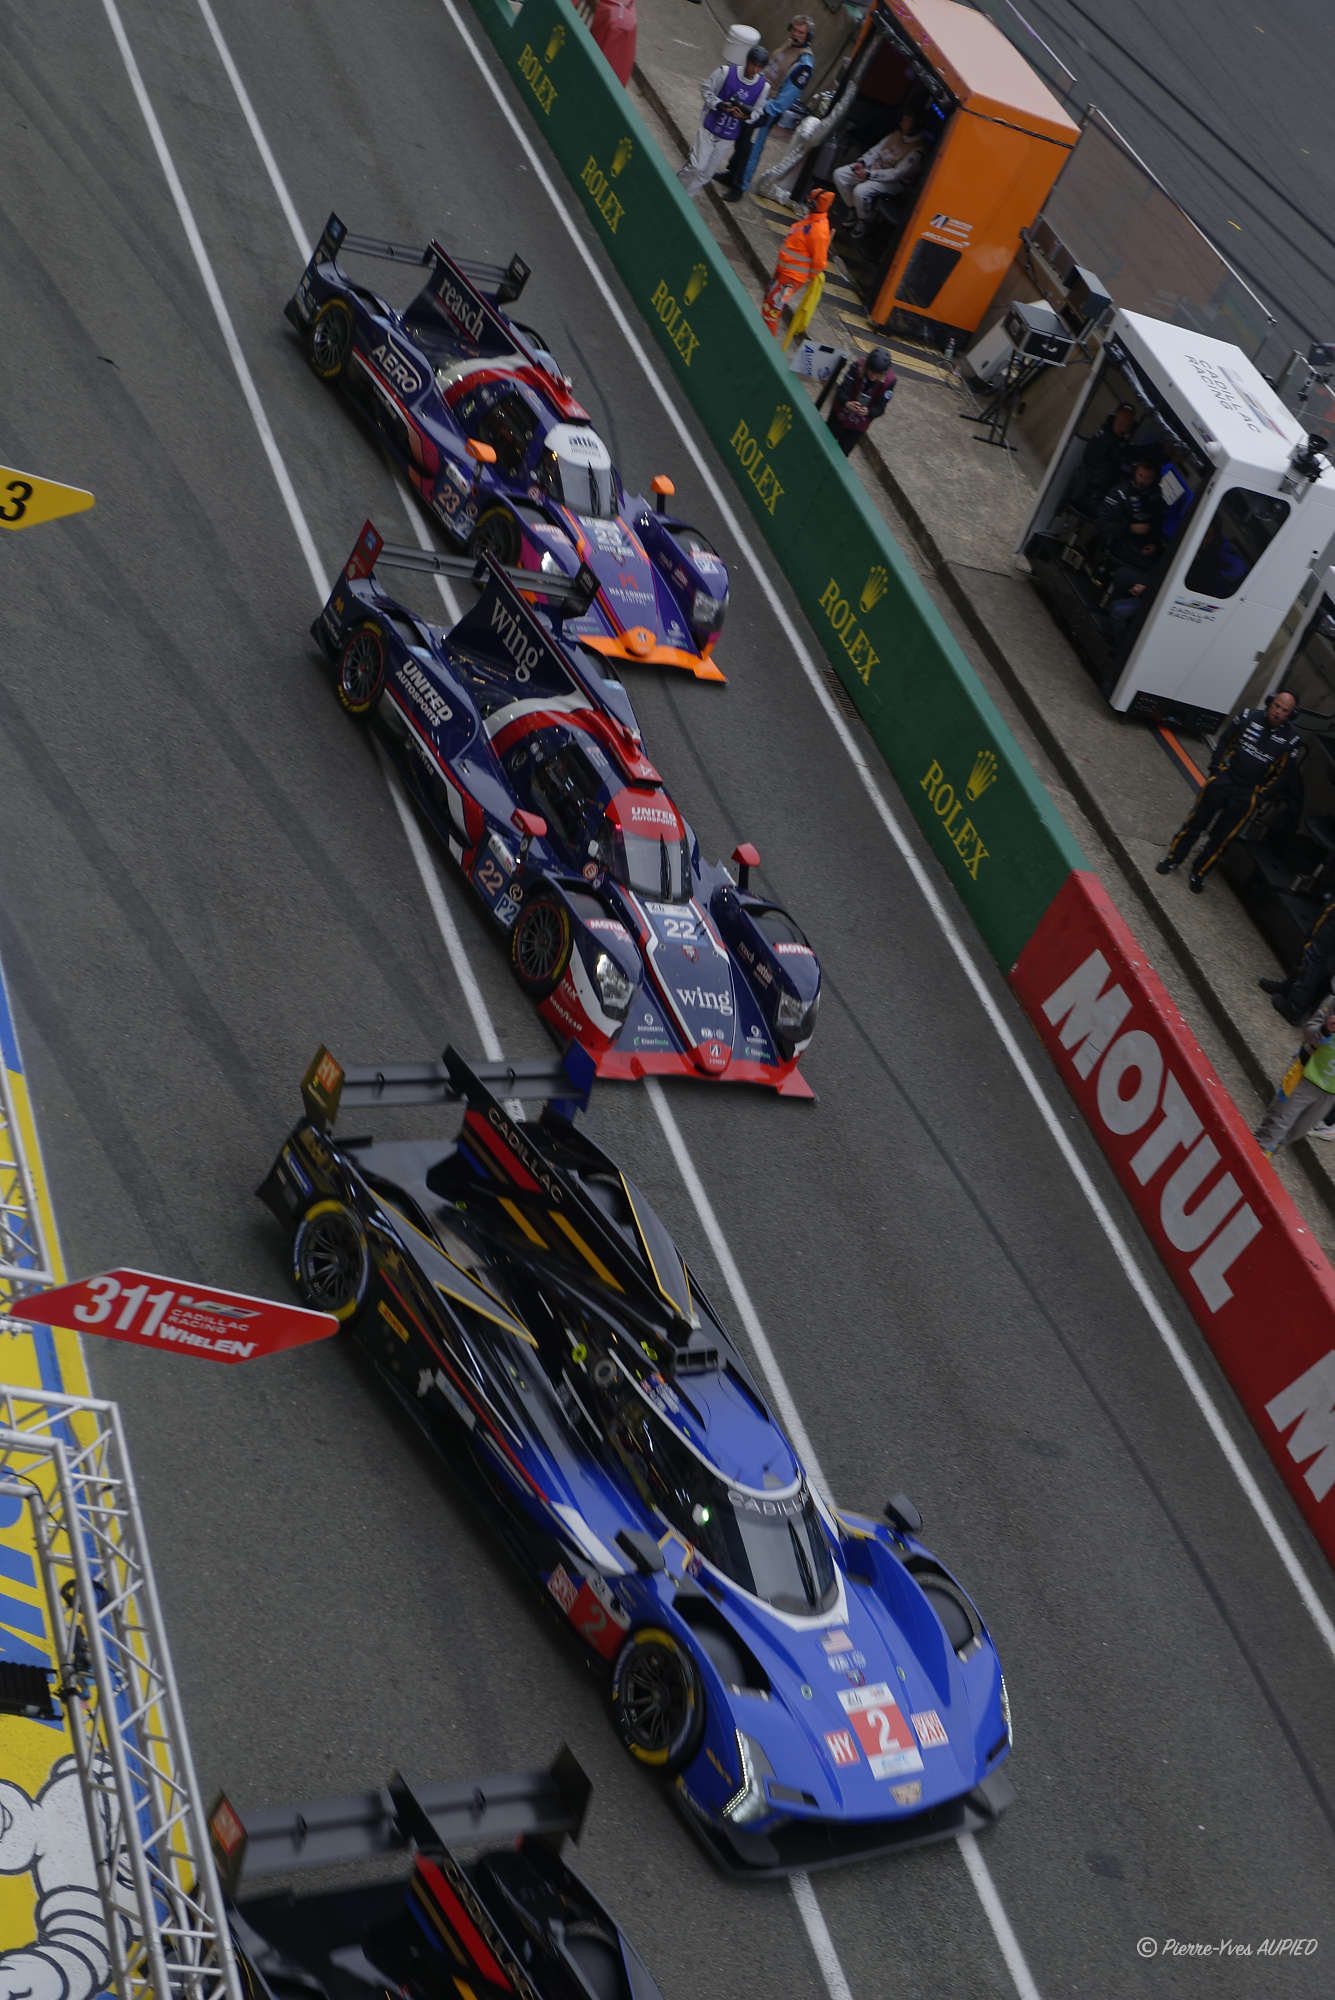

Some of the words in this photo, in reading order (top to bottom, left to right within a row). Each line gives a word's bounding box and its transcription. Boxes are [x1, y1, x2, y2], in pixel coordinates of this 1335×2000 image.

[517, 43, 558, 116] ROLEX
[580, 155, 626, 234] ROLEX
[650, 279, 700, 366] ROLEX
[371, 344, 419, 394] AERO
[1184, 354, 1234, 411] RACING
[1200, 359, 1261, 433] CADILLAC
[730, 419, 786, 515] ROLEX
[490, 596, 544, 683] wing
[818, 578, 881, 685] ROLEX
[394, 669, 441, 727] AUTOSPORTS
[403, 659, 453, 721] UNITED
[631, 806, 676, 823] UNITED
[919, 759, 990, 881] ROLEX
[478, 859, 504, 896] 22
[496, 897, 517, 922] P2
[663, 918, 698, 940] 22
[676, 986, 733, 1017] wing
[489, 1107, 563, 1205] CADILLAC
[1041, 949, 1264, 1314] MOTUL
[72, 1276, 177, 1337] 311
[166, 1315, 227, 1334] RACING
[170, 1308, 251, 1332] CADILLAC
[159, 1322, 259, 1358] WHELEN
[581, 1603, 607, 1646] 2
[827, 1732, 857, 1765] HY
[867, 1708, 901, 1753] 2
